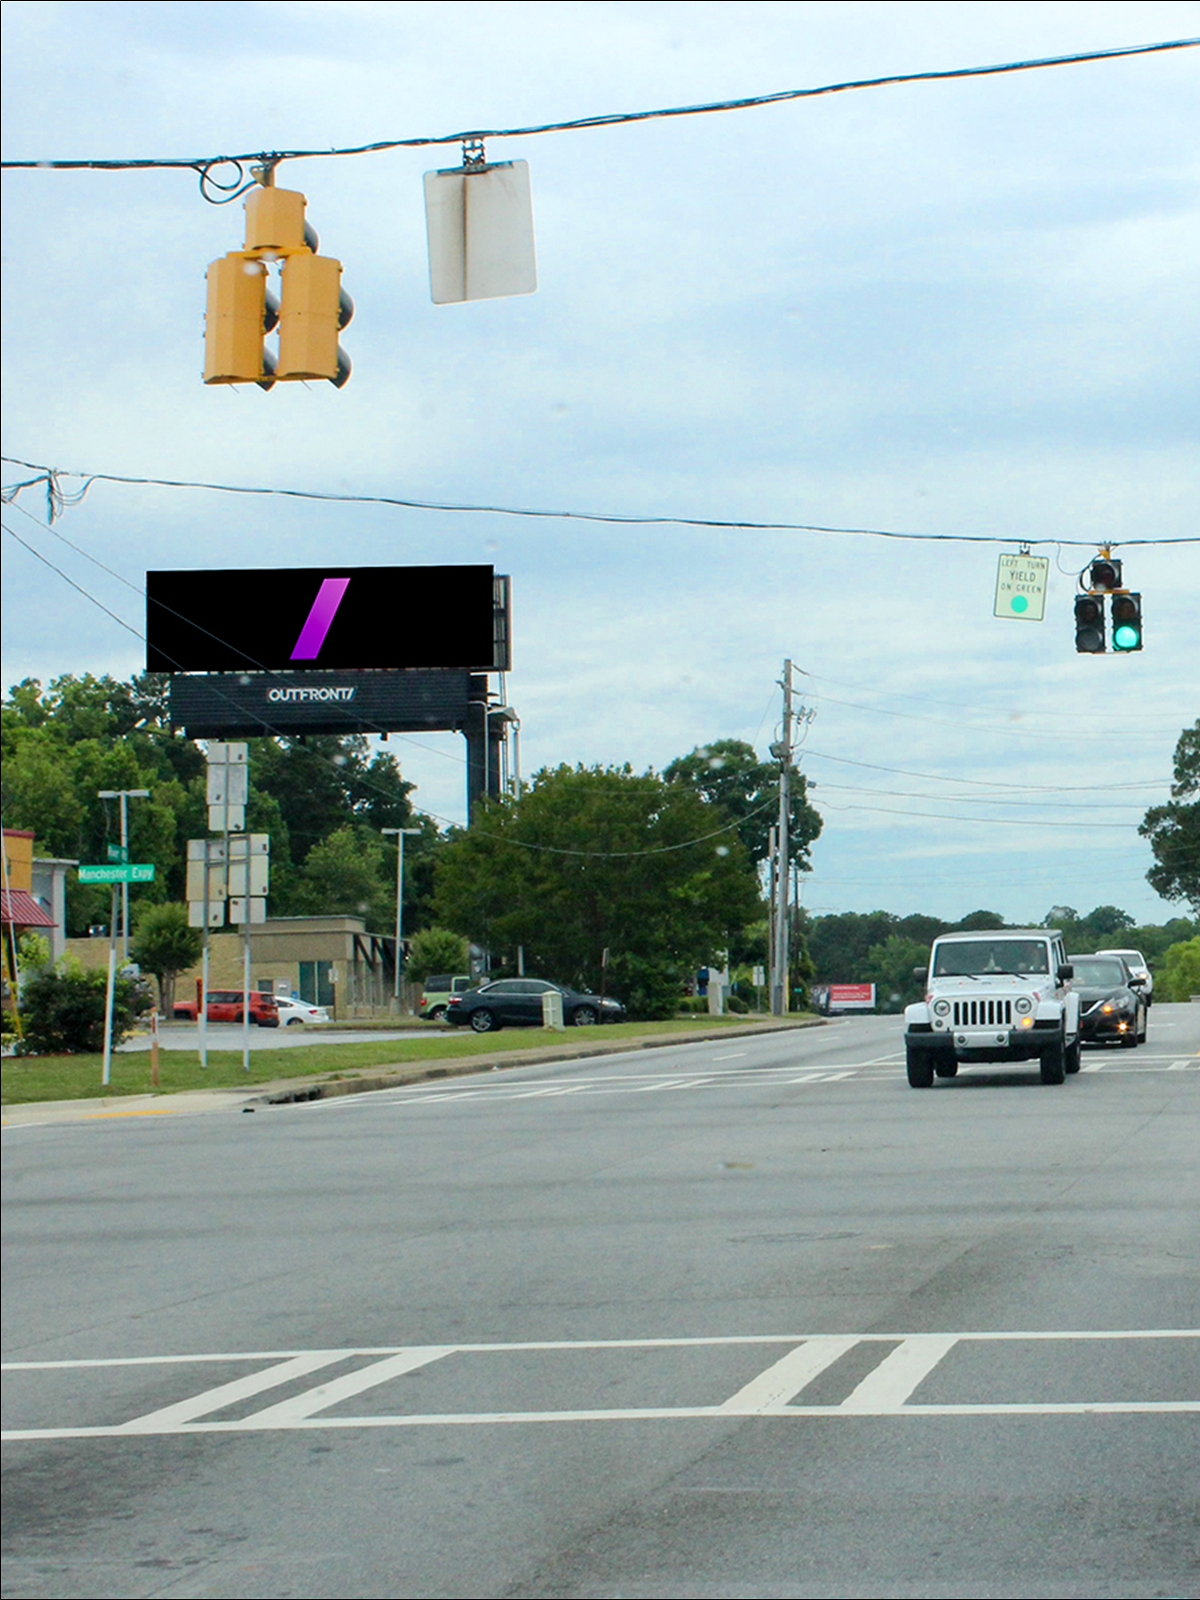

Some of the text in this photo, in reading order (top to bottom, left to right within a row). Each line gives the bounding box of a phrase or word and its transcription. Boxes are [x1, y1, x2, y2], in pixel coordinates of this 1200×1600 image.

[1001, 560, 1046, 569] LEFT TURN
[1010, 571, 1036, 582] YIELD
[1001, 583, 1041, 593] ON GREEN
[78, 867, 152, 881] Manchester Expy
